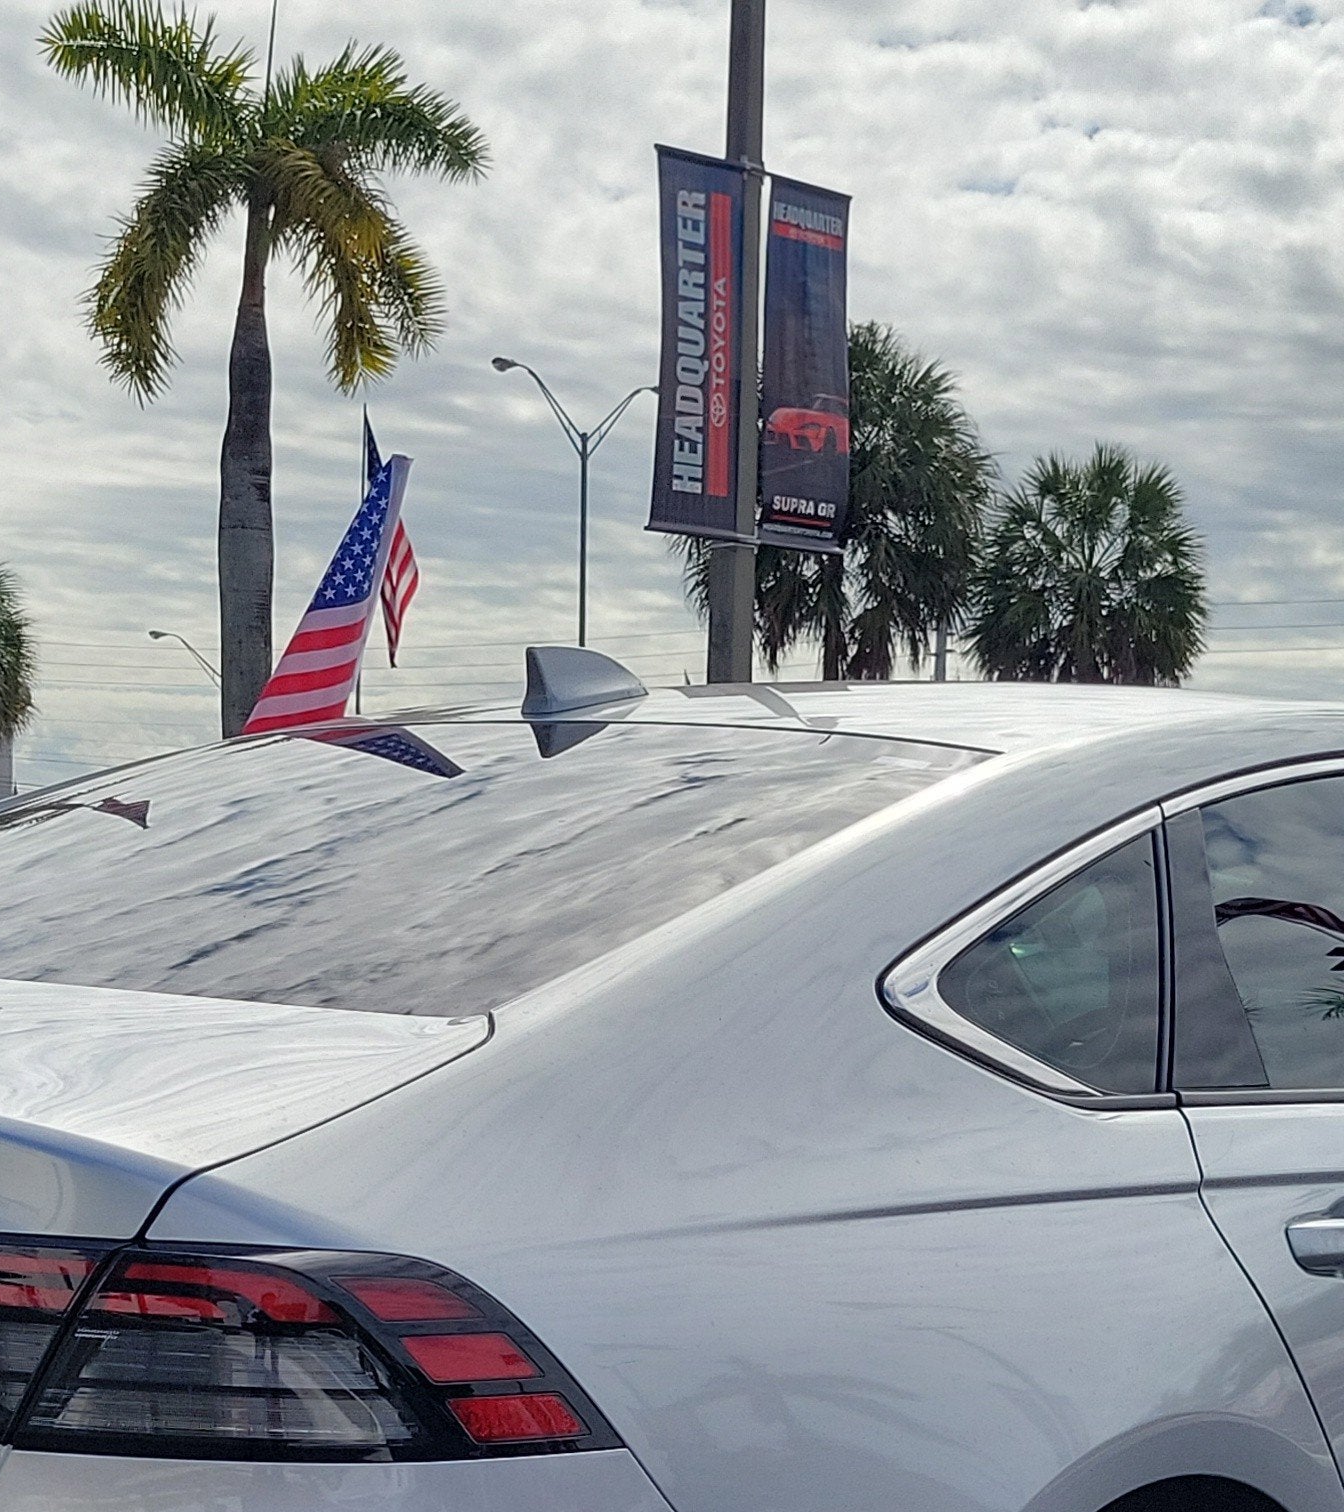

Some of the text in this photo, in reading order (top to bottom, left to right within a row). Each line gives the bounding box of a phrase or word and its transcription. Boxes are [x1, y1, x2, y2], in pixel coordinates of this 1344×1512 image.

[672, 189, 709, 495] HEADQUARTER
[711, 276, 728, 387] TOYOTA
[772, 495, 836, 518] SUPRA GR
